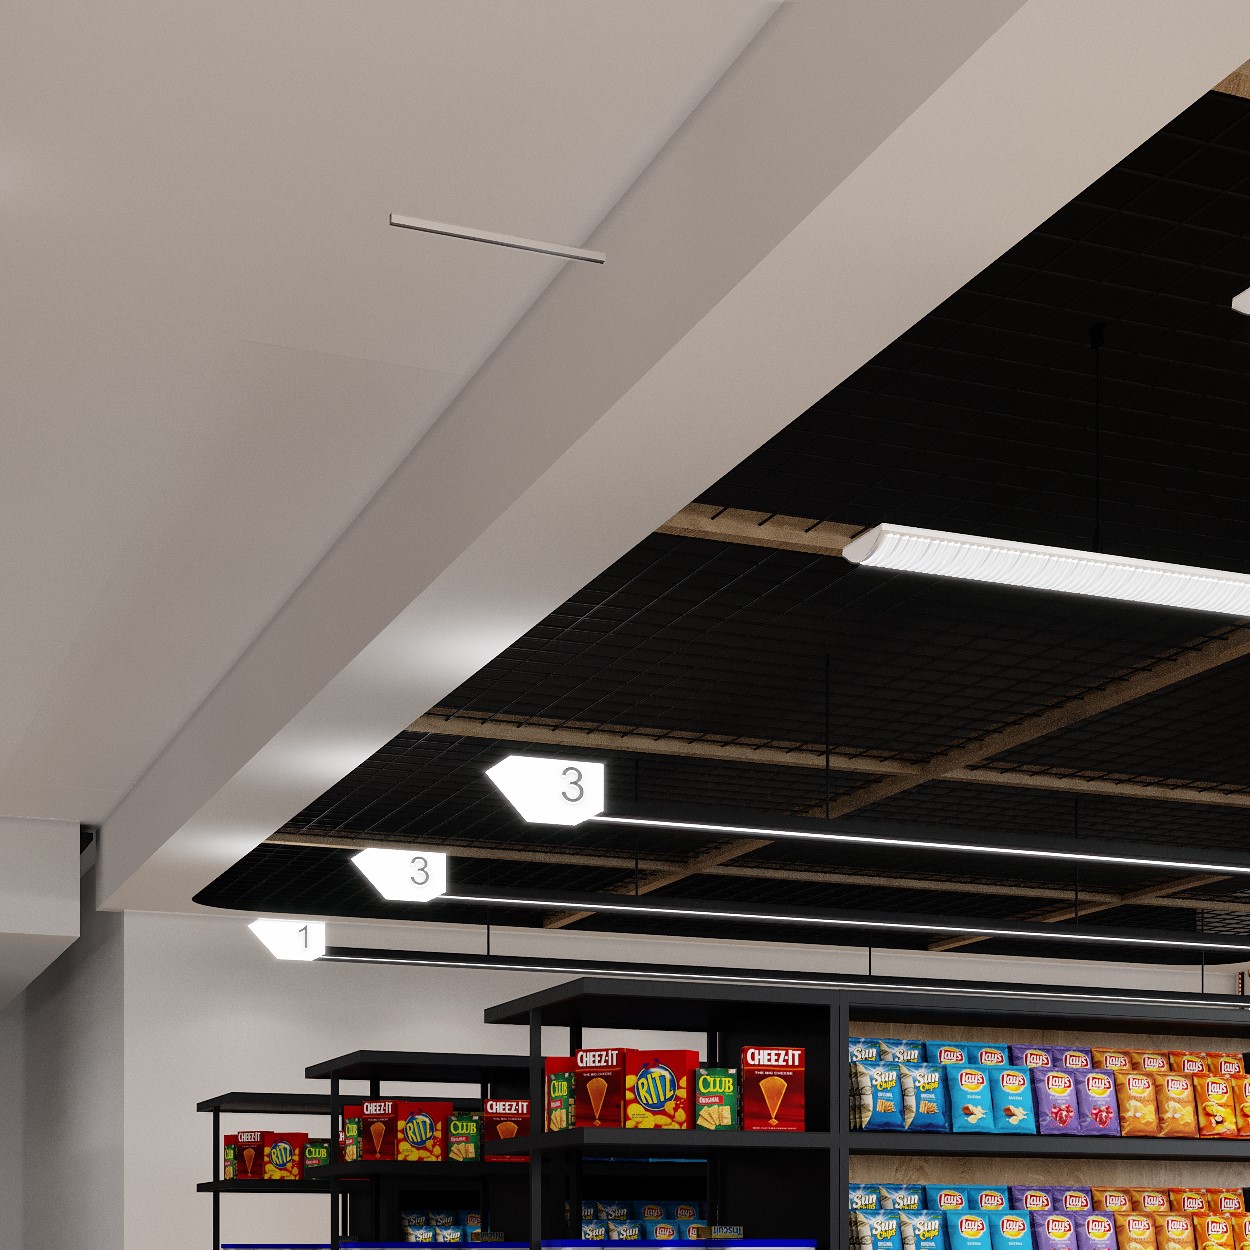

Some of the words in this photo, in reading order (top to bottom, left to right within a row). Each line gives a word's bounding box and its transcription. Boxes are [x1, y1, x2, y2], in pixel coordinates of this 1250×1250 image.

[562, 767, 584, 802] 3
[411, 857, 429, 885] 3
[299, 925, 308, 948] 1
[577, 1050, 619, 1067] CHEEZ-IT
[747, 1049, 801, 1066] CHEEZ-IT
[853, 1048, 877, 1061] Sun
[896, 1049, 918, 1062] Sun
[940, 1049, 962, 1060] Lay's
[981, 1051, 1004, 1062] Lay's
[1222, 1061, 1240, 1072] Lay's
[699, 1075, 733, 1093] CLUB
[872, 1071, 897, 1086] Sun
[915, 1072, 938, 1086] Sun
[962, 1073, 984, 1084] Lay's
[1003, 1074, 1025, 1086] Lay's
[1049, 1074, 1071, 1086] Lay's
[1089, 1075, 1110, 1087] Lay's
[1129, 1077, 1149, 1088] Lay's
[1168, 1078, 1188, 1089] Lay's
[638, 1072, 675, 1105] RITZ
[1208, 1081, 1227, 1094] Lay's
[364, 1102, 393, 1114] CHEEZ-IT
[487, 1101, 528, 1114] CHEEZ-IT
[407, 1118, 432, 1143] RITZ
[450, 1121, 477, 1135] CLUB
[271, 1142, 292, 1165] RITZ
[306, 1146, 327, 1158] CLUB
[872, 1220, 897, 1234] Sun
[915, 1220, 938, 1235] Sun
[962, 1219, 984, 1230] Lay's
[1003, 1219, 1025, 1231] Lay's
[1049, 1220, 1071, 1231] Lay's
[1089, 1220, 1111, 1232] Lay's
[1129, 1220, 1149, 1231] Lay's
[1168, 1220, 1188, 1231] Lay's
[1208, 1220, 1227, 1233] Lay's
[586, 1227, 605, 1238] Sun
[619, 1227, 639, 1238] Sun
